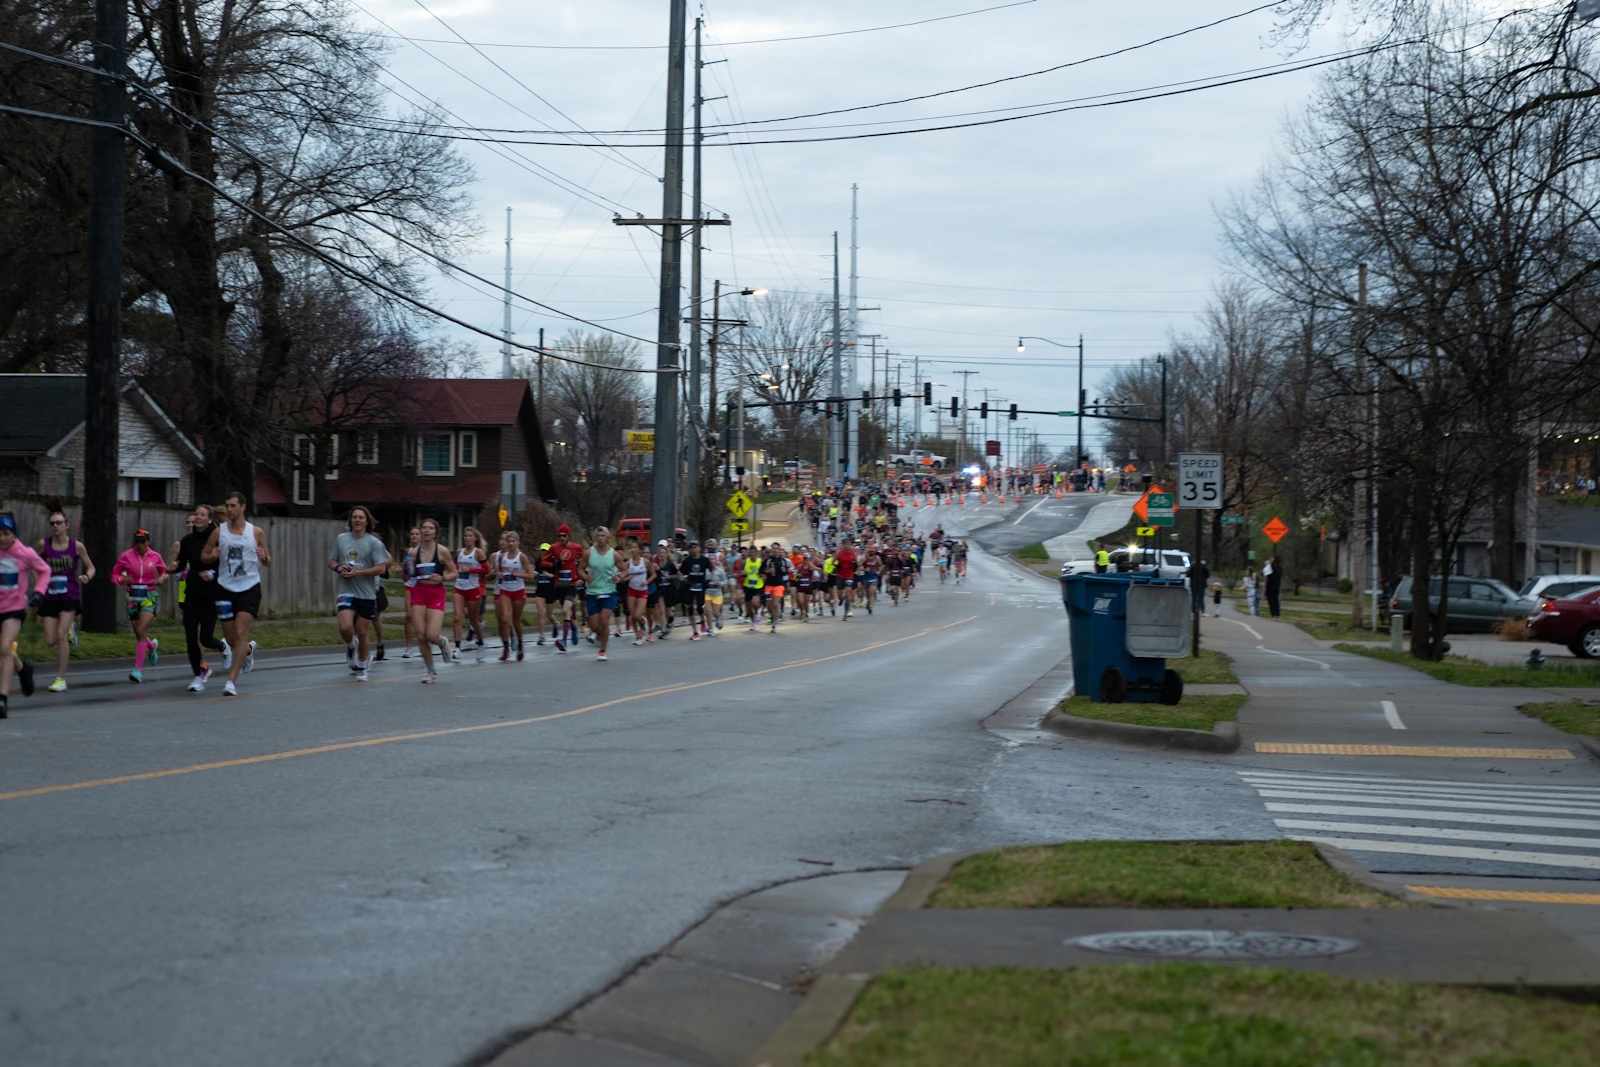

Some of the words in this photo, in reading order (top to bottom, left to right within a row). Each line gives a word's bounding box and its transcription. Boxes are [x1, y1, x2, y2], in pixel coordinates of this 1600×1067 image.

[1182, 459, 1219, 468] SPEED
[1185, 470, 1215, 479] LIMIT
[1182, 481, 1218, 501] 35
